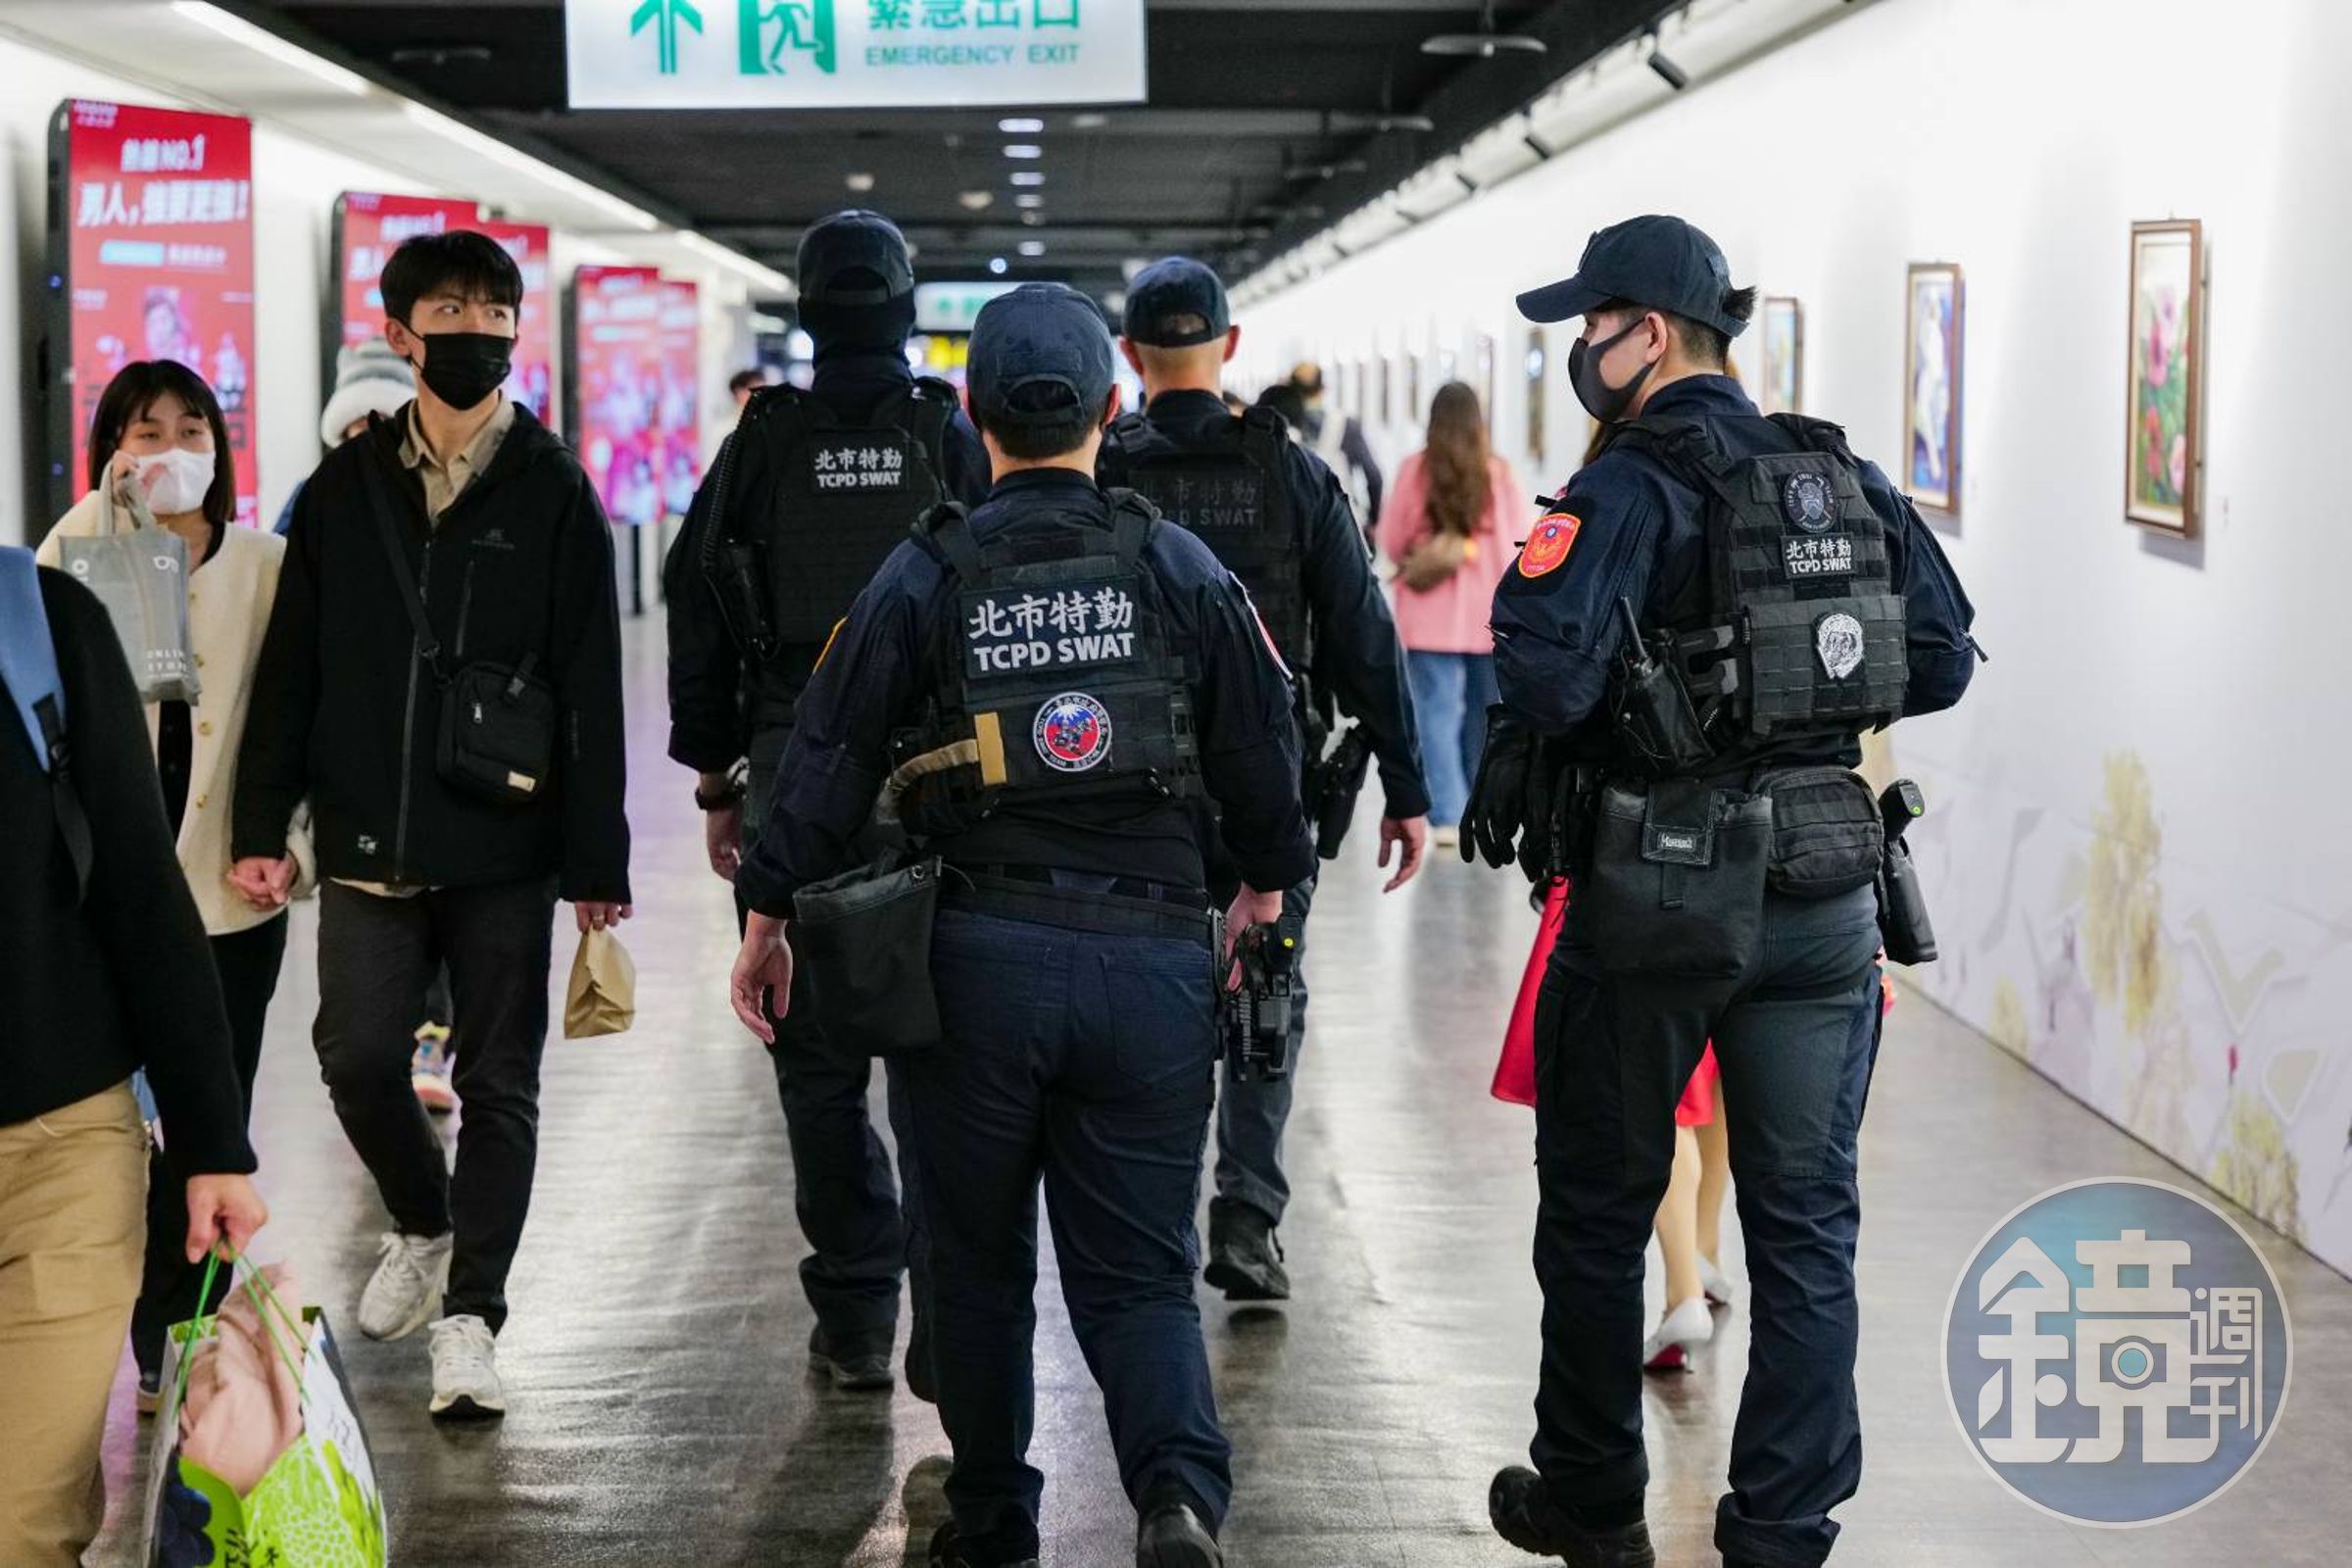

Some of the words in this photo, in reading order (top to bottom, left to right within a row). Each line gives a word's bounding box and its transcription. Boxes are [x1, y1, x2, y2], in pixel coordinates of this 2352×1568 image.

[865, 44, 1013, 66] EMERGENCY
[1027, 43, 1079, 64] EXIT
[814, 447, 903, 470] 北市特勤
[817, 473, 857, 488] TCPD
[859, 471, 901, 486] SWAT
[1787, 539, 1852, 560] 北市特勤
[1789, 561, 1821, 573] TCPD
[1823, 558, 1851, 571] SWAT
[968, 586, 1133, 640] 北市特勤
[974, 641, 1052, 671] TCPD
[1056, 632, 1135, 663] SWAT
